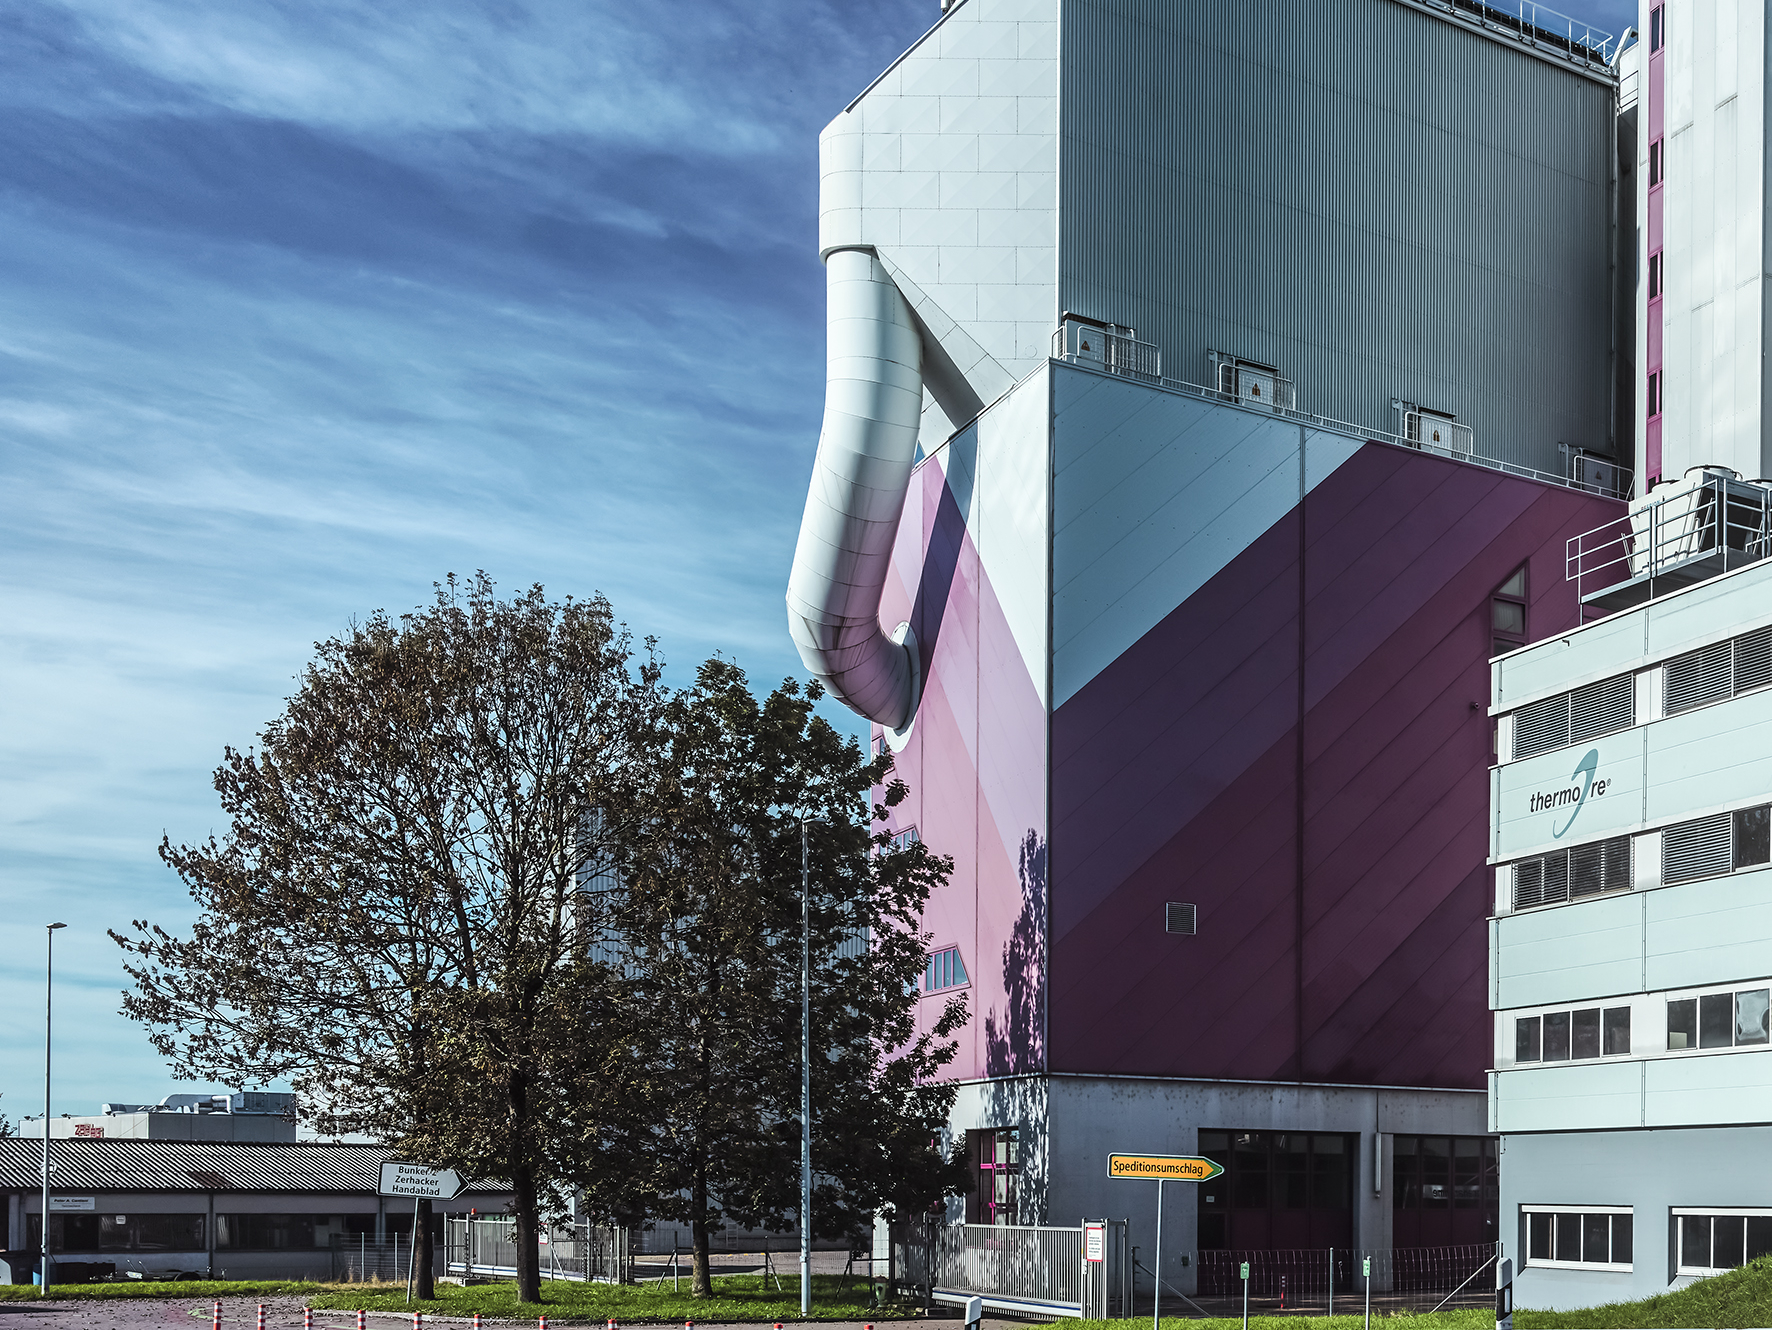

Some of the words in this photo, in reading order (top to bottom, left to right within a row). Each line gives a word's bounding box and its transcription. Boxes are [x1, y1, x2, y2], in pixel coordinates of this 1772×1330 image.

[398, 1165, 431, 1176] Bunker
[1113, 1160, 1204, 1177] Speditionsumschlag
[394, 1175, 440, 1186] Zerhacker
[392, 1185, 440, 1196] Handablad
